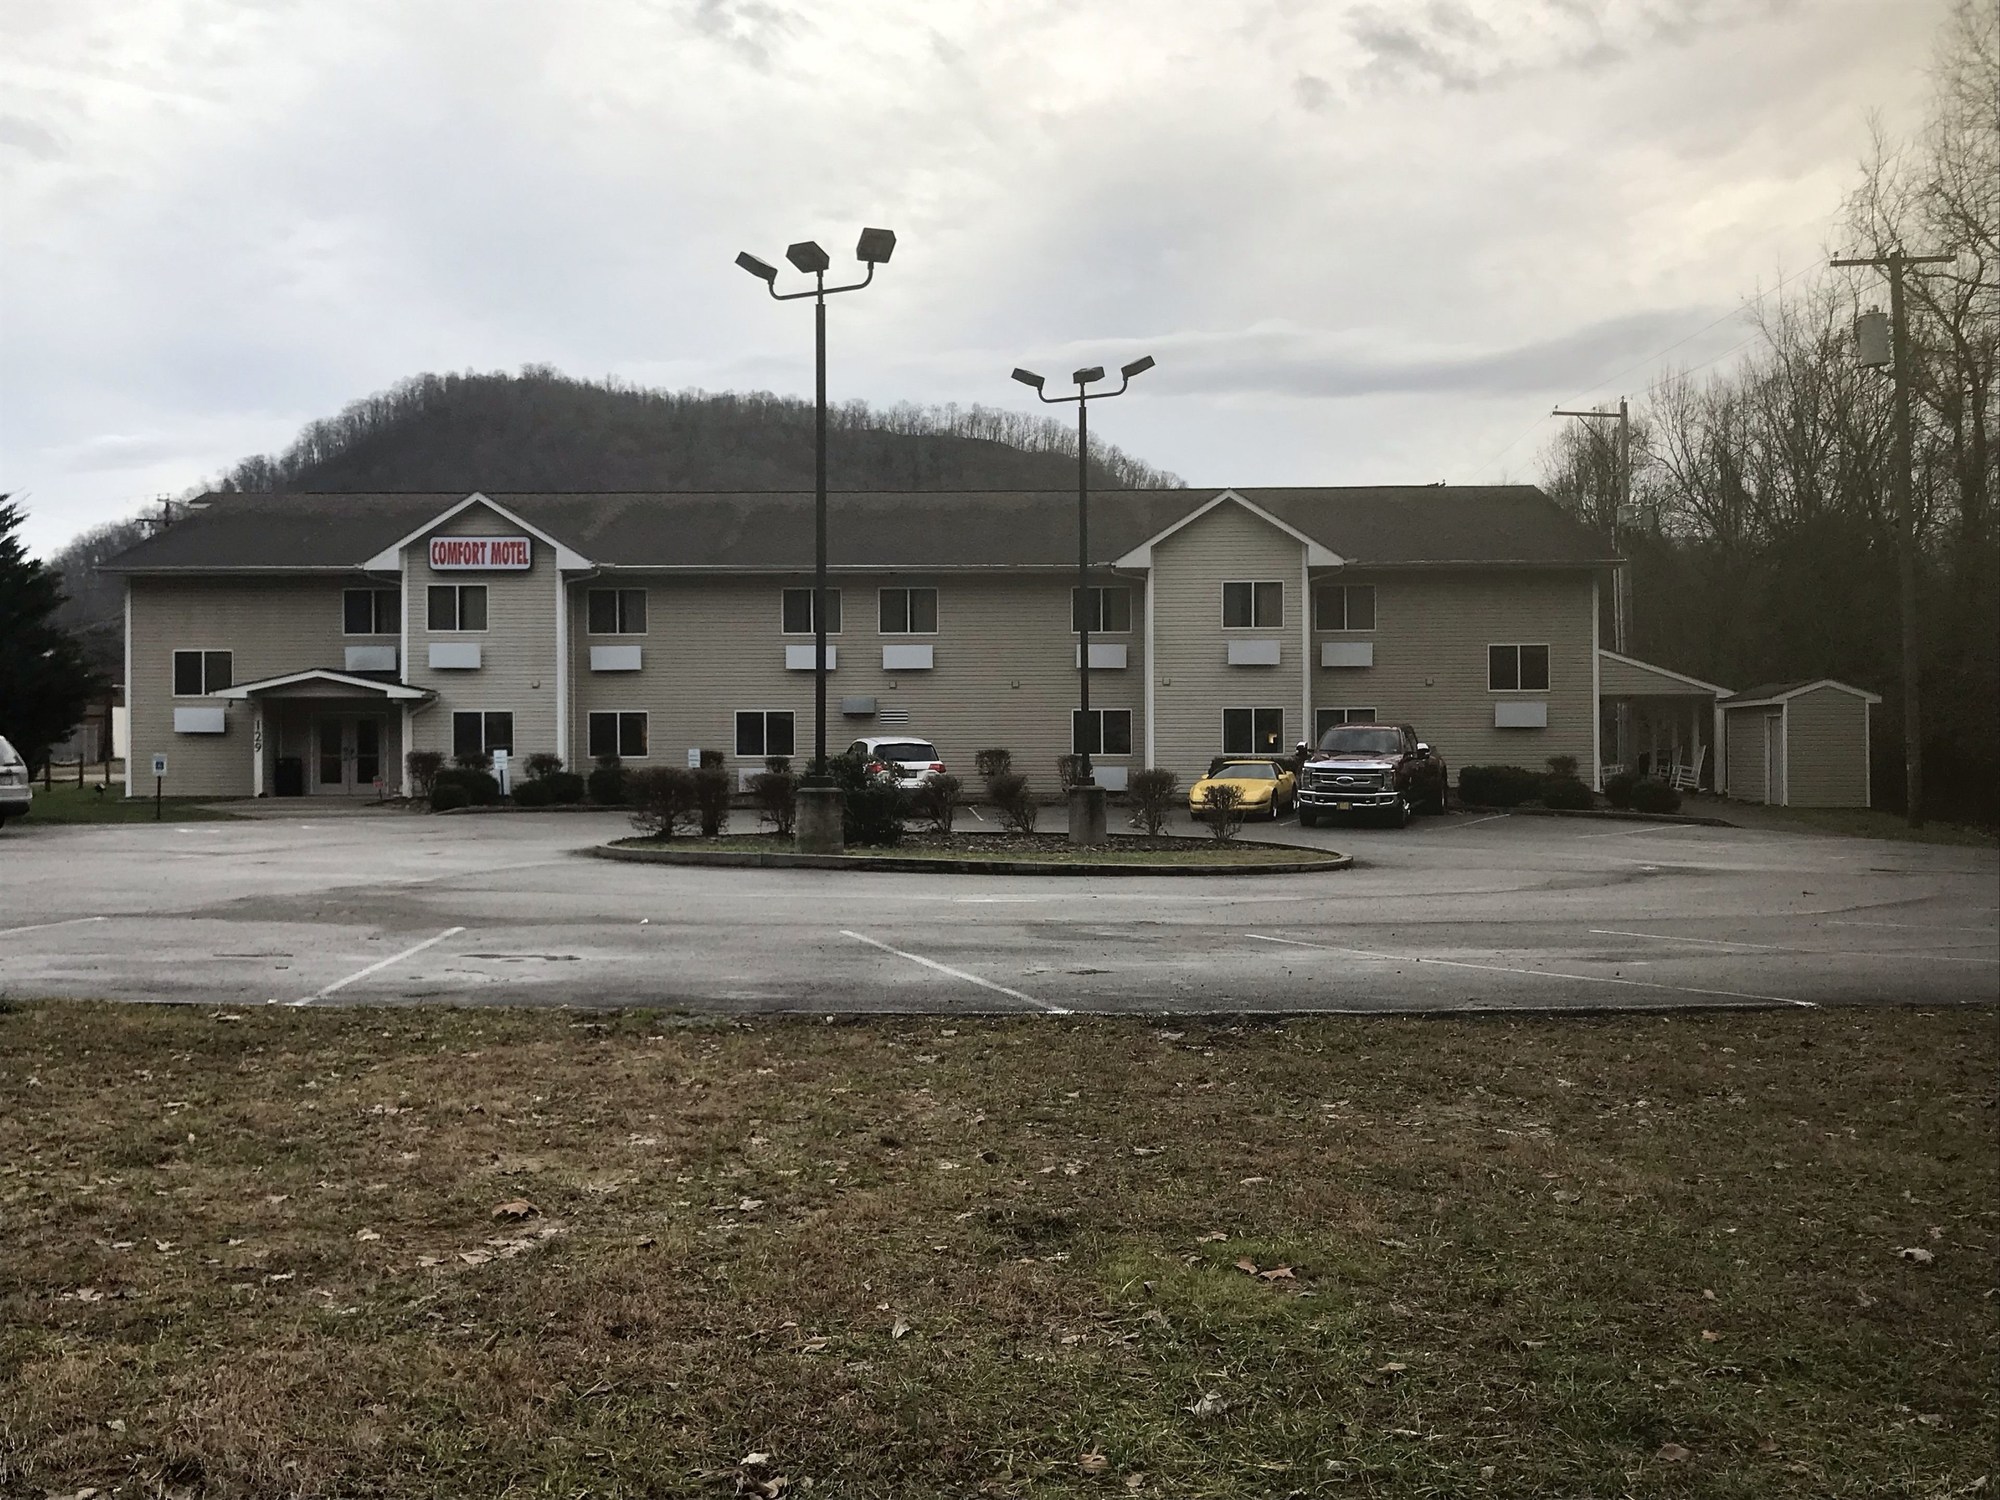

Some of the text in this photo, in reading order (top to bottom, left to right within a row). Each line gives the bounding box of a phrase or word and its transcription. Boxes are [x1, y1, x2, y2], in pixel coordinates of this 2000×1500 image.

[432, 541, 529, 565] COMFORT MOTEL
[254, 719, 262, 753] 129
